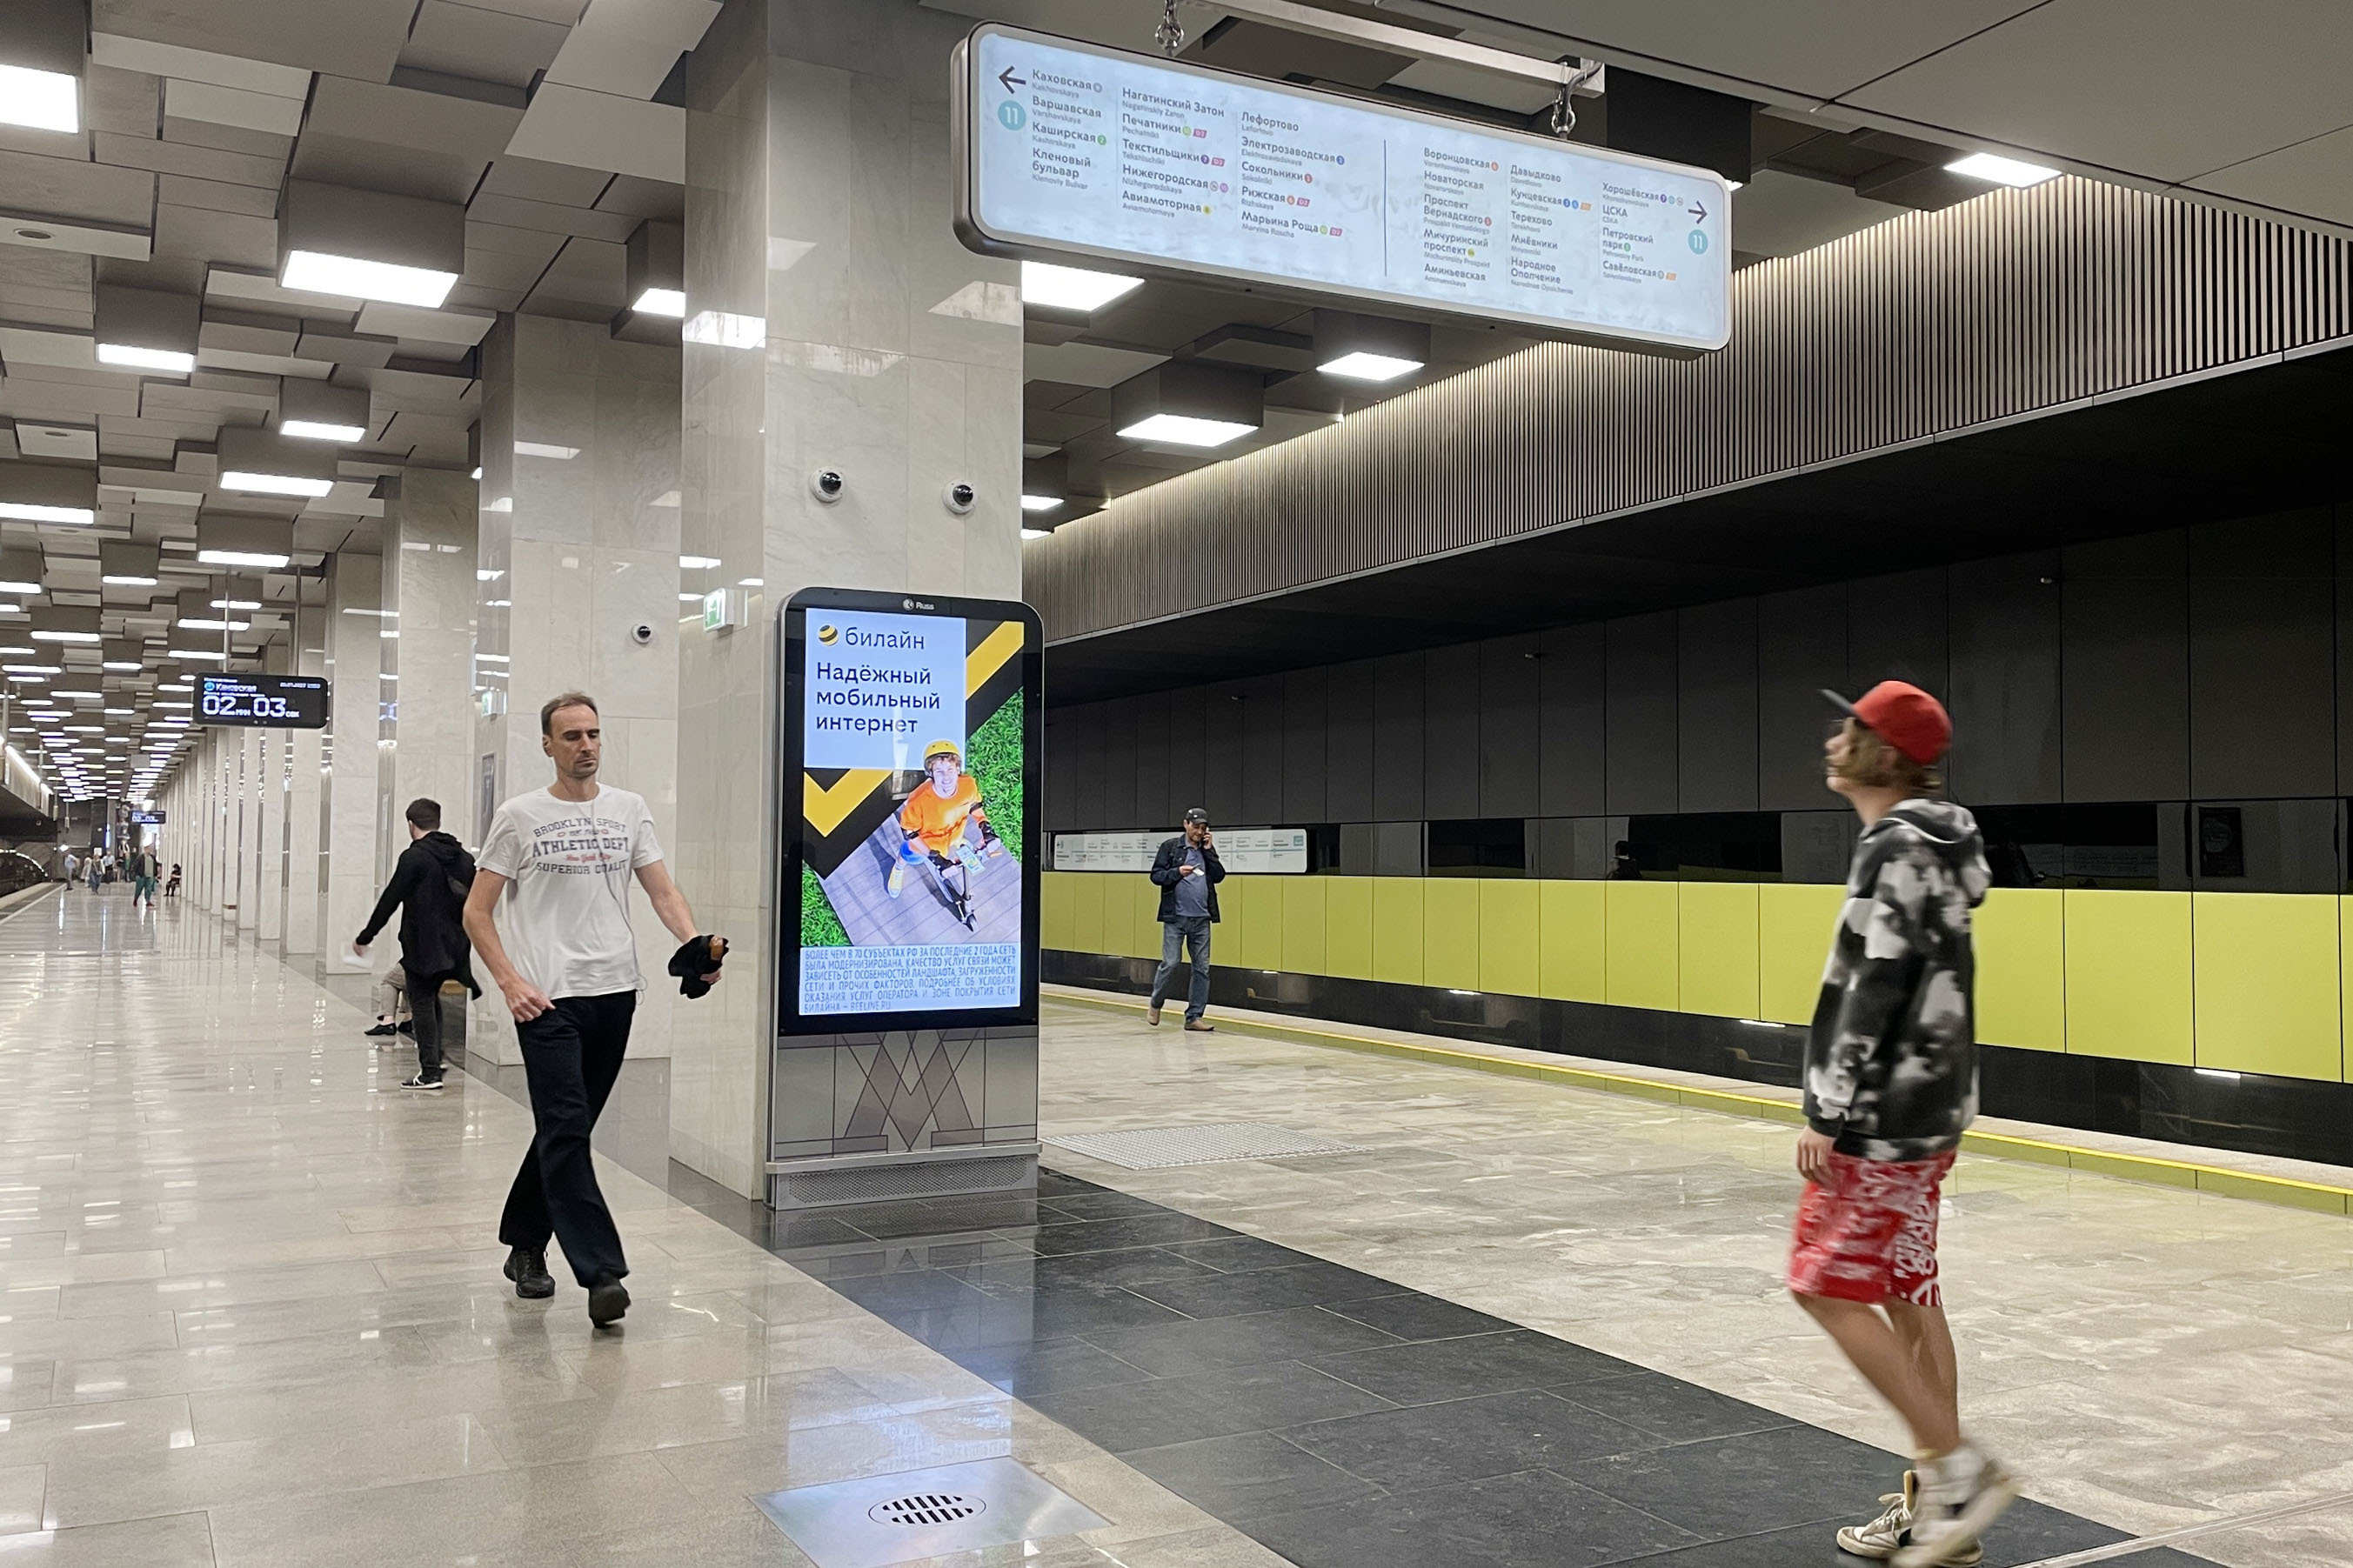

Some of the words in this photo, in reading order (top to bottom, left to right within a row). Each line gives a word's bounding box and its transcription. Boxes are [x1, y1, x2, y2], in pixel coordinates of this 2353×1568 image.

[1033, 69, 1092, 90] Каховская
[1033, 96, 1101, 118] Варшавская
[1122, 87, 1192, 110] Нагатинский
[1193, 102, 1225, 117] Затон
[1005, 107, 1019, 124] 11
[1122, 114, 1181, 134] Печатники
[1241, 111, 1299, 131] Лефортово
[1033, 122, 1096, 143] Каширская
[1033, 148, 1091, 167] Кленовый
[1123, 139, 1200, 162] Текстильщики
[1241, 137, 1335, 163] Электрозаводская
[1424, 147, 1490, 169] Воронцовская
[1033, 161, 1080, 178] бульвар
[1123, 164, 1208, 189] Нижегородская
[1241, 161, 1303, 181] Сокольники
[1510, 164, 1561, 183] Давыдково
[1424, 170, 1484, 190] Новаторская
[1241, 186, 1286, 203] Рижская
[1511, 188, 1562, 205] Кунцевская
[1602, 183, 1660, 201] Хорошёвская
[1122, 190, 1201, 213] Авиамоторная
[1424, 194, 1468, 210] Проспект
[1424, 206, 1483, 224] Вернадского
[1511, 210, 1552, 226] Терехово
[1602, 205, 1628, 217] ЦСКА
[1241, 210, 1289, 228] Марьина
[1292, 219, 1319, 234] Роща
[1424, 229, 1488, 247] Мичуринский
[1511, 234, 1558, 250] Мнёвники
[1602, 227, 1654, 244] Петровский
[1693, 235, 1703, 250] 11
[1424, 242, 1466, 255] проспект
[1602, 240, 1623, 250] парк
[1424, 264, 1486, 281] Аминьевская
[1511, 257, 1556, 272] Народное
[1603, 261, 1657, 277] Савёловская
[1511, 268, 1561, 284] Ополчение
[846, 626, 925, 650] билайн
[817, 662, 931, 684] Надёжный
[203, 696, 236, 716] 02
[253, 697, 286, 717] 03
[817, 688, 940, 710] мобильный
[816, 715, 918, 736] интернет
[533, 817, 592, 837] BROOKLYN
[532, 838, 599, 857] ATHLETIC
[536, 862, 590, 874] SUPERIOR
[805, 950, 828, 959] БОЛЕЕ
[831, 949, 846, 959] ЧЕМ
[848, 949, 852, 958] В
[864, 948, 905, 958] СУБЪЕКТАХ
[907, 947, 918, 957] РФ
[920, 947, 928, 957] ЗА
[930, 946, 973, 957] ПОСЛЕДНИЕ
[979, 945, 998, 956] ГОДА
[999, 945, 1016, 955] СЕТЬ
[805, 960, 826, 971] БЫЛА
[906, 957, 942, 967] КАЧЕСТВО
[944, 957, 966, 966] УСЛУГ
[967, 956, 989, 965] СВЯЗИ
[993, 955, 1016, 964] МОЖЕТ
[805, 971, 841, 981] ЗАВИСЕТЬ
[843, 970, 852, 980] ОТ
[854, 968, 910, 979] ОСОБЕННОСТЕЙ
[959, 965, 1015, 976] ЗАГРУЖЕННОСТИ
[805, 982, 824, 991] СЕТИ
[829, 982, 834, 991] И
[839, 980, 869, 991] ПРОЧИХ
[919, 977, 961, 988] ПОДРОБНЕЕ
[965, 977, 974, 986] ОБ
[979, 975, 1015, 985] УСЛОВИЯХ
[805, 992, 846, 1003] ОКАЗАНИЯ
[850, 991, 872, 1001] УСЛУГ
[878, 989, 918, 999] ОПЕРАТОРА
[922, 989, 928, 998] И
[932, 988, 950, 998] ЗОНЕ
[955, 986, 993, 997] ПОКРЫТИЯ
[998, 986, 1015, 996] СЕТИ
[805, 1003, 839, 1013] БИЛАЙНА
